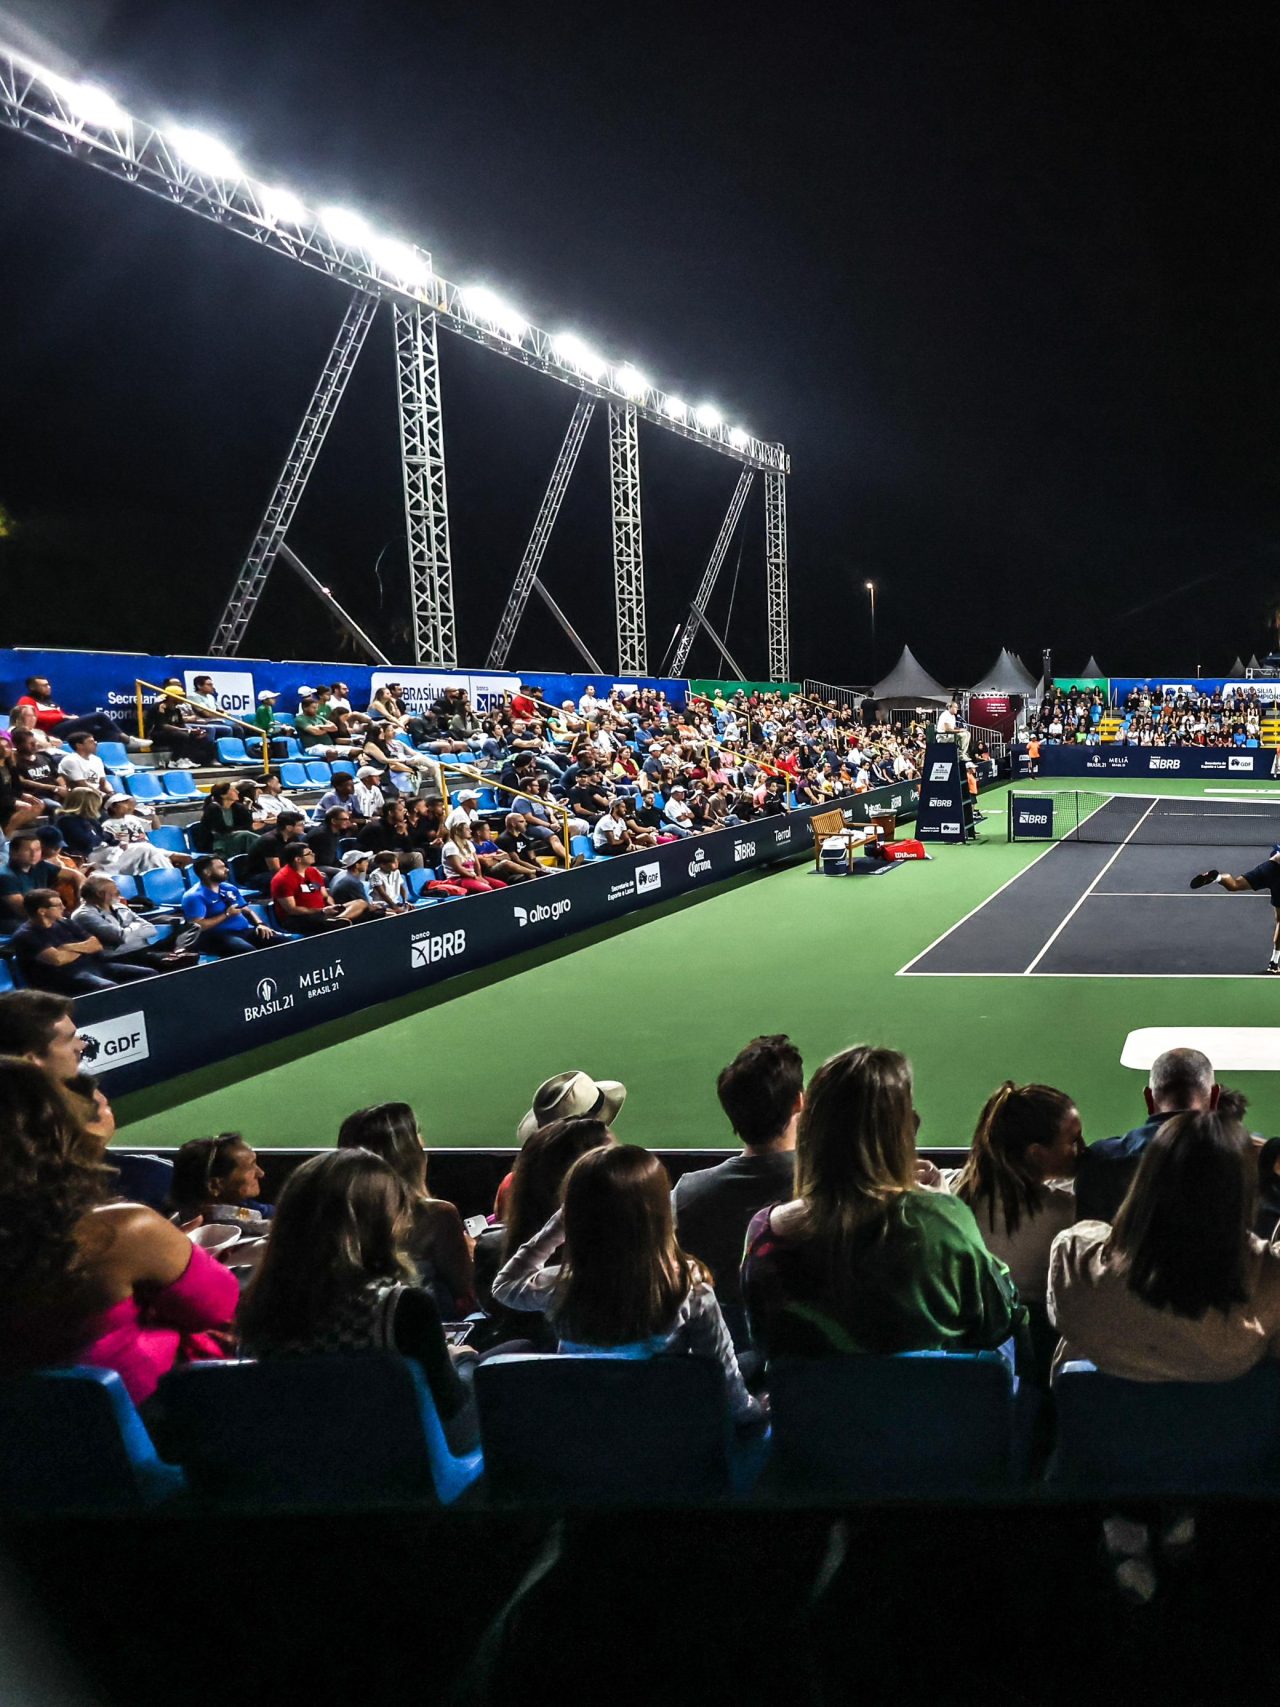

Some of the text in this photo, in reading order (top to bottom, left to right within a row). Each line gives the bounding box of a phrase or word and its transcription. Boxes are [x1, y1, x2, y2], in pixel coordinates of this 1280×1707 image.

[221, 694, 250, 710] GDF
[1160, 759, 1180, 769] BRB
[1029, 815, 1048, 824] BRB
[774, 826, 791, 842] Terral
[742, 842, 756, 859] BRB
[688, 860, 712, 878] Corona
[648, 873, 658, 883] GDF
[530, 898, 571, 923] alto giro
[411, 930, 430, 941] banco
[431, 929, 466, 962] BRB
[299, 958, 345, 989] MELIÃ
[308, 982, 340, 999] BRASIL 21
[104, 1032, 141, 1056] GDF
